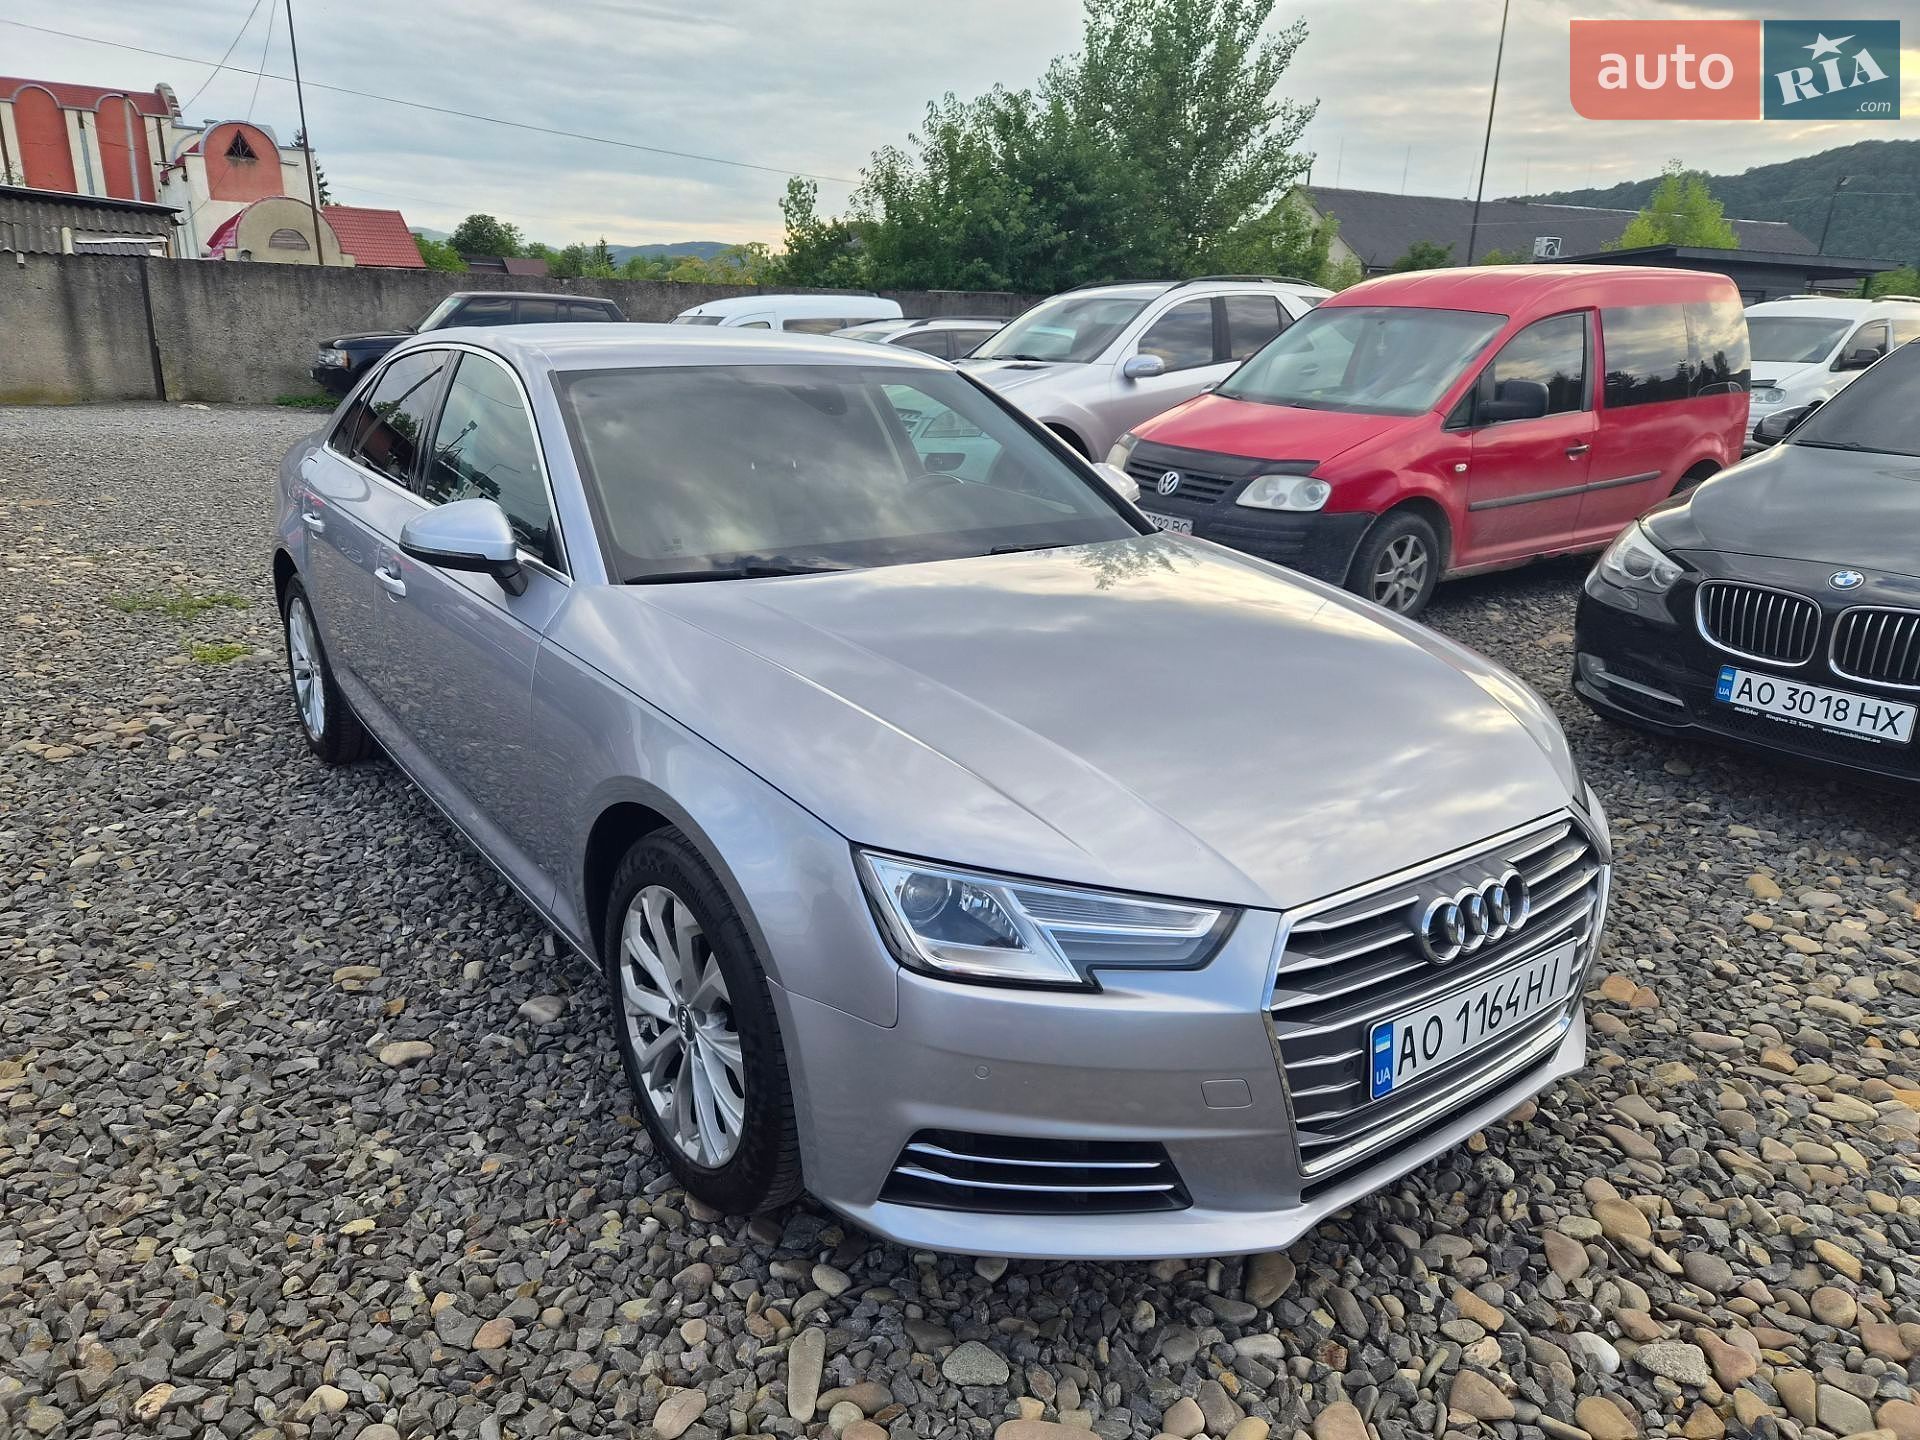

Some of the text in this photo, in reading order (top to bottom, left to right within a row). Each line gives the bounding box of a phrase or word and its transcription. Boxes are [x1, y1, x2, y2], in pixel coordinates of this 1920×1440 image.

[1718, 687, 1730, 697] UA
[1736, 677, 1905, 735] AO 3018 HX
[1397, 1015, 1443, 1077] AO
[1375, 1069, 1391, 1086] UA
